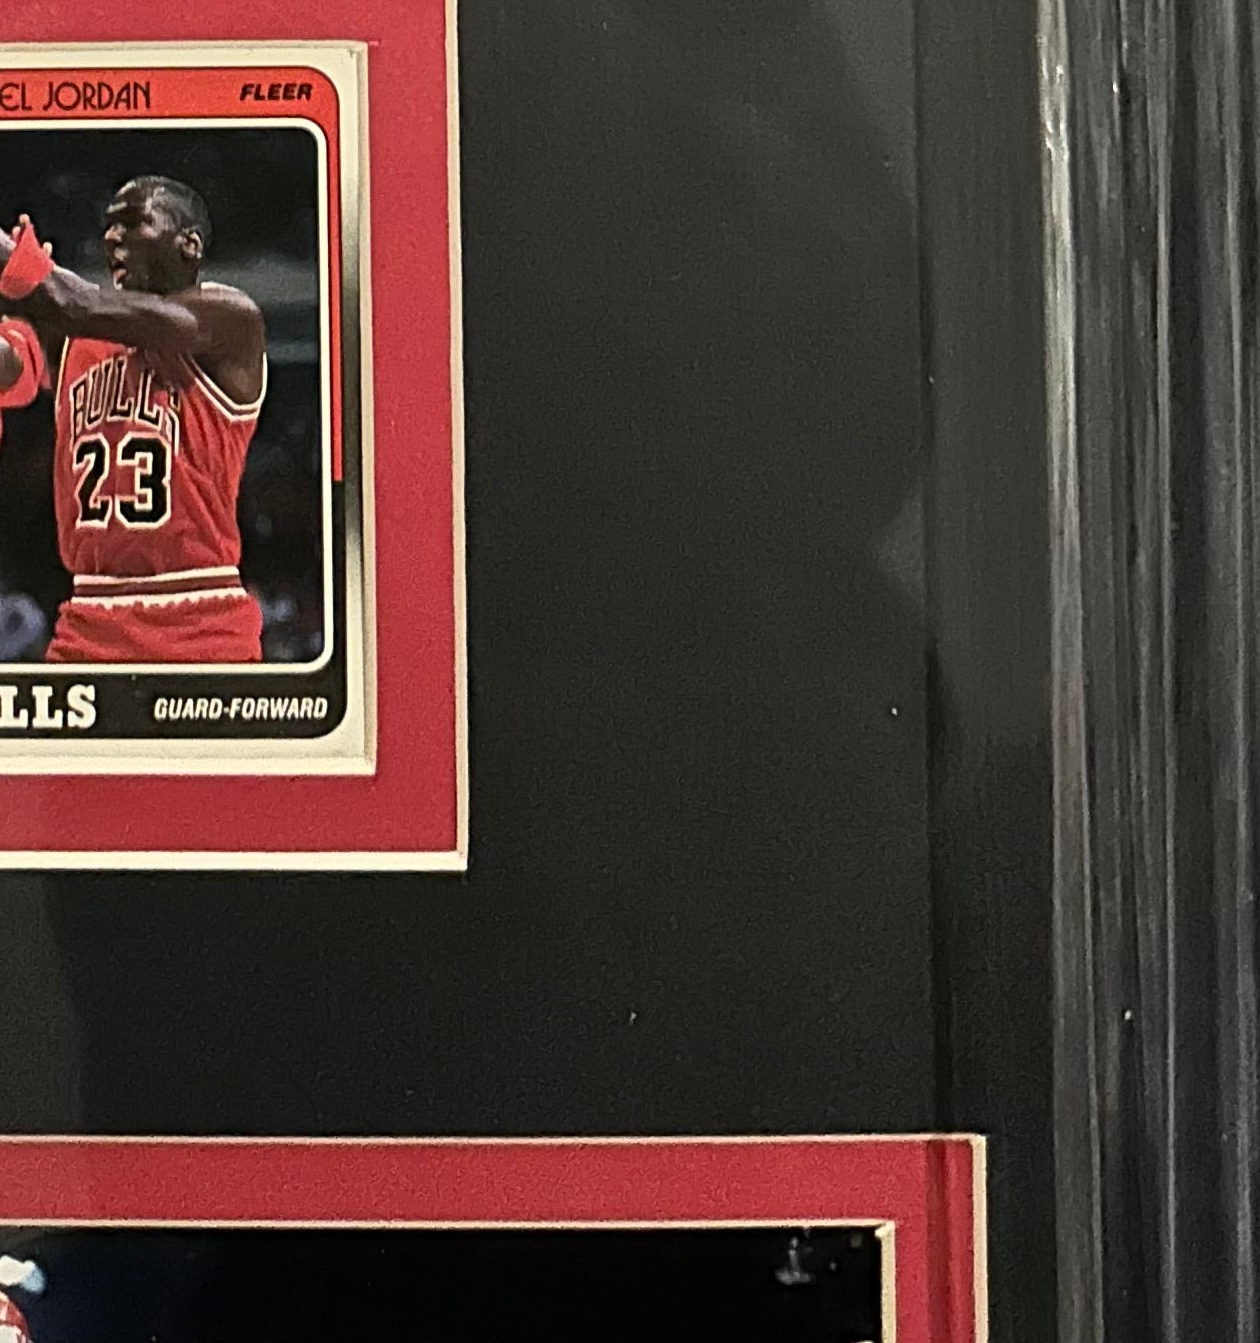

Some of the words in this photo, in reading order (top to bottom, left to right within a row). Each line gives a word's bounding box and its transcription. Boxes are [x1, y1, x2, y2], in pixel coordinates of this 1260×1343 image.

[42, 80, 151, 112] JORDAN
[240, 82, 313, 102] FLEER
[71, 431, 173, 530] 23
[154, 696, 330, 721] GUARD-FORWARD
